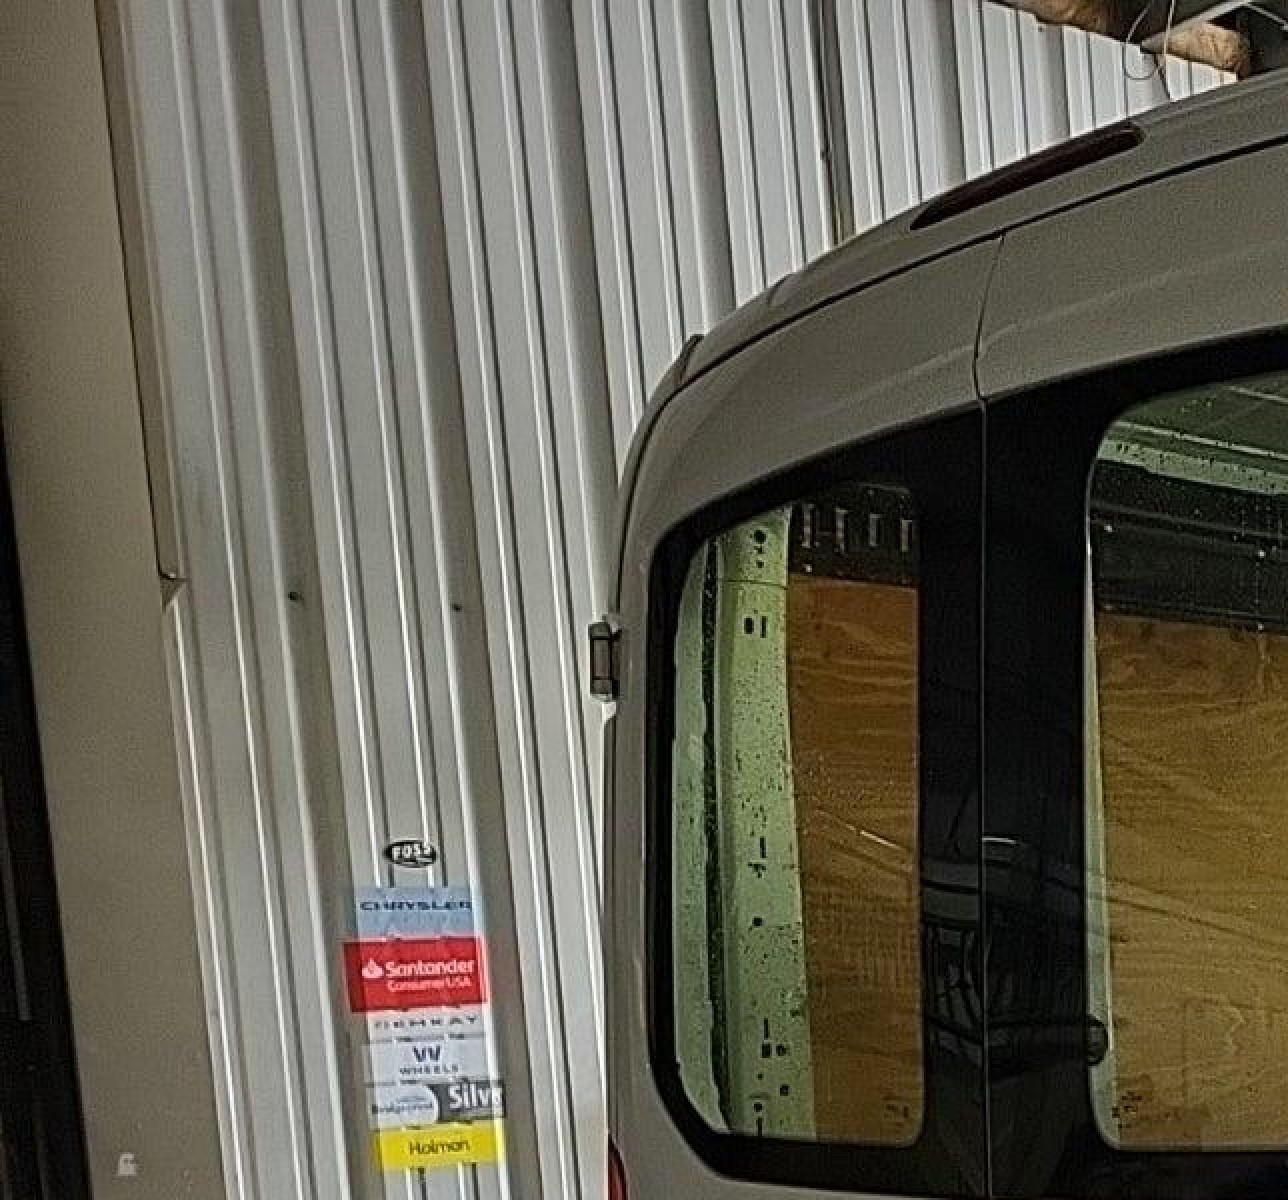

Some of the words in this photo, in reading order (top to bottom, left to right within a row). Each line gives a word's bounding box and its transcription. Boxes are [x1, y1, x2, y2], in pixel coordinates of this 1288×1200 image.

[360, 901, 472, 910] CHRYSLER
[386, 960, 474, 976] Santander
[409, 1140, 470, 1155] Holman
